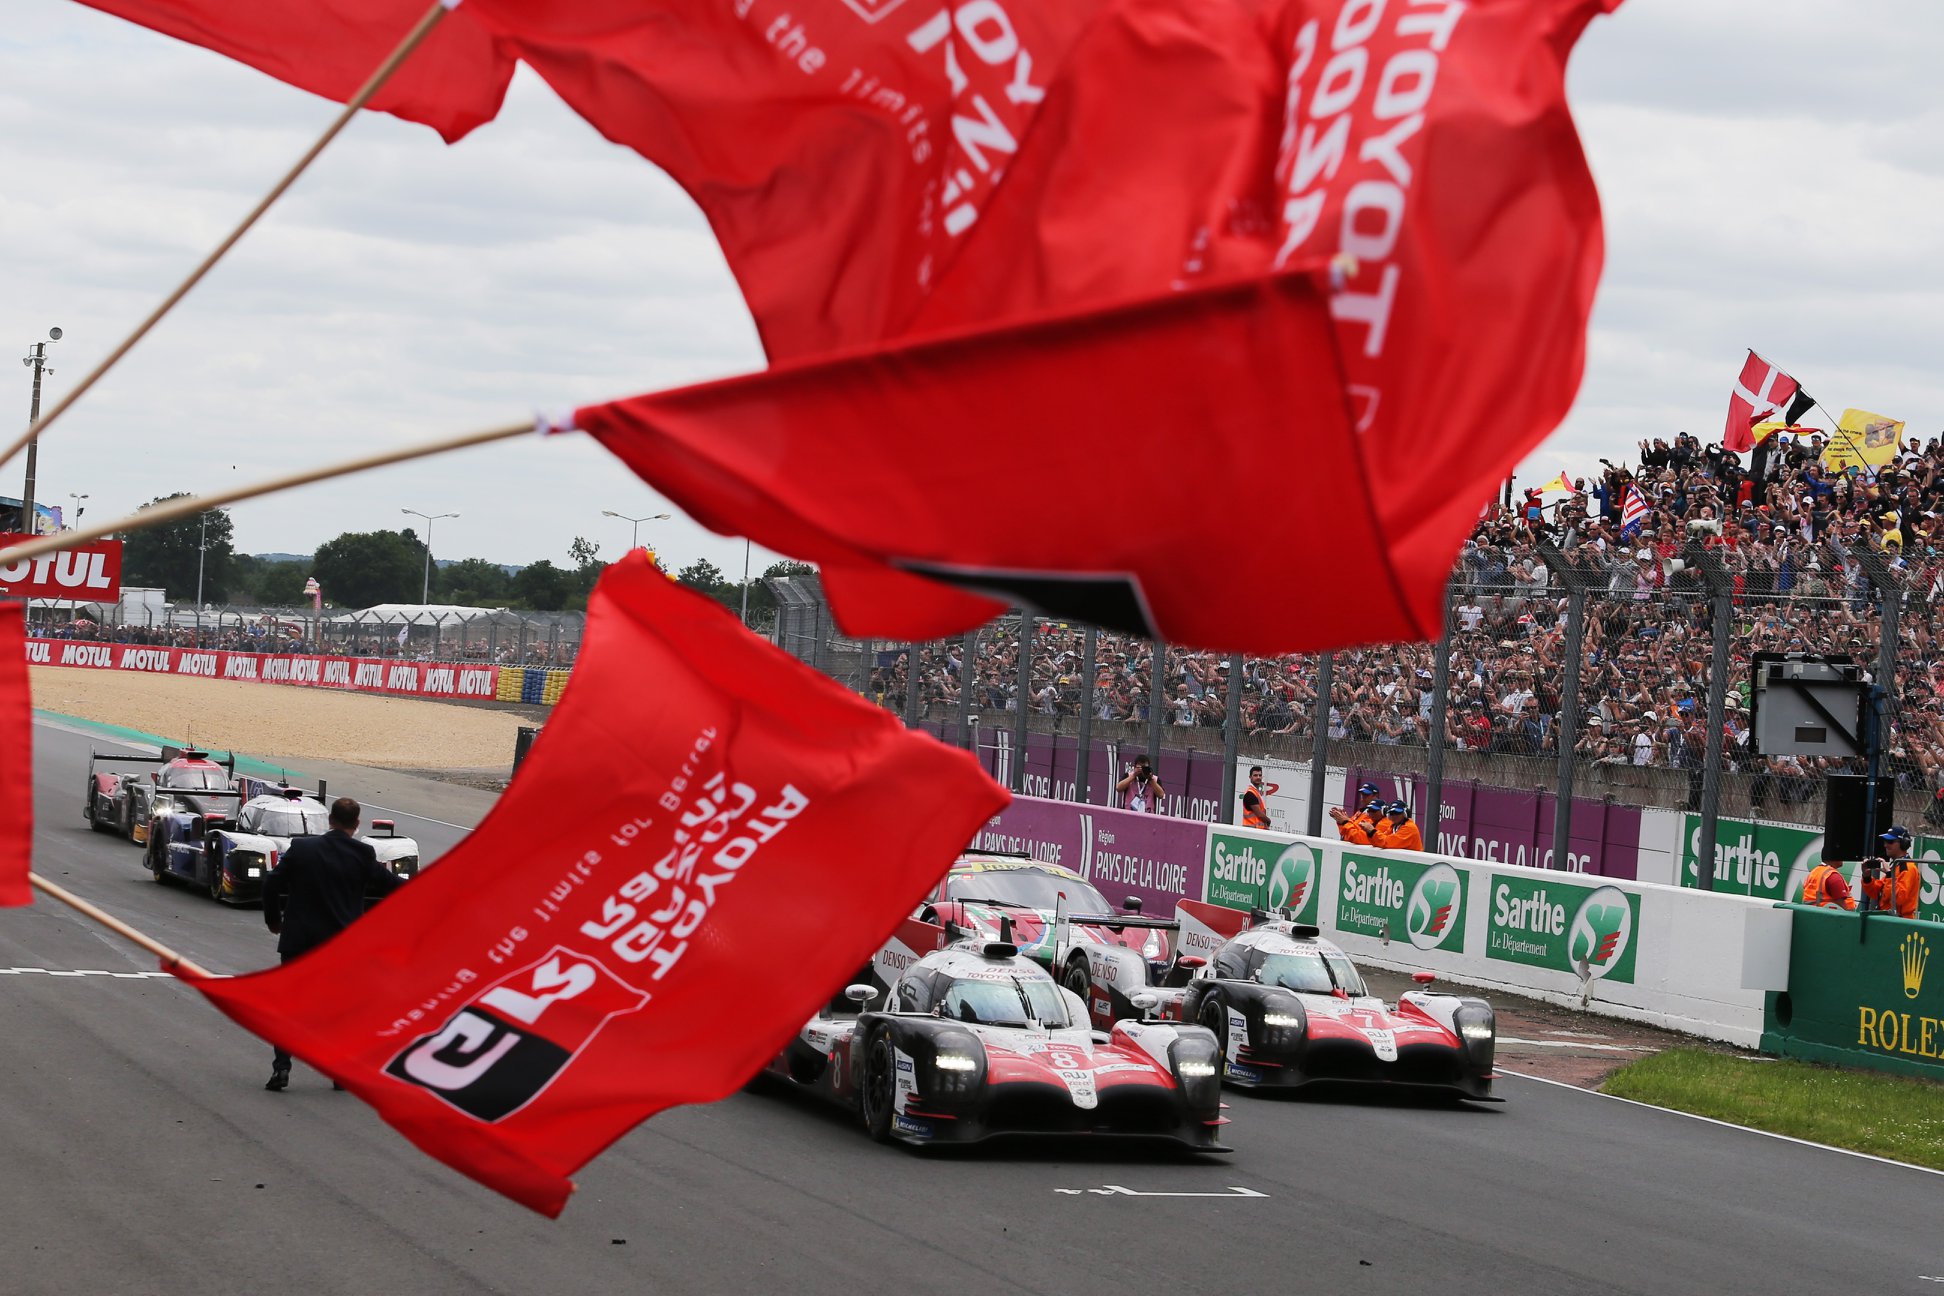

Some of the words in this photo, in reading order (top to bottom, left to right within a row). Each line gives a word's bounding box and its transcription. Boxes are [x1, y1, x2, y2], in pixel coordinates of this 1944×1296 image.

[765, 12, 827, 75] the
[840, 67, 932, 165] limits
[0, 546, 111, 589] OTUL
[26, 642, 51, 663] TUL
[61, 644, 112, 668] MOTUL
[120, 649, 170, 672] MOTUL
[178, 652, 217, 676] MOTUL
[224, 656, 258, 679] MOTUL
[262, 658, 290, 680] MOTUL
[290, 658, 319, 682] MOTUL
[323, 660, 350, 684] MOTUL
[354, 663, 383, 688] MOTUL
[388, 666, 418, 692] MOTUL
[424, 668, 455, 693] MOTUL
[458, 670, 492, 696] MOTUL
[1098, 828, 1116, 846] Région
[1437, 832, 1467, 859] AYS
[1095, 850, 1123, 885] PAYS
[1123, 855, 1139, 886] DE
[1139, 858, 1154, 888] LA
[1154, 861, 1188, 895] LOIRE
[1213, 841, 1267, 888] Sarthe
[1211, 883, 1220, 898] Le
[1220, 885, 1253, 905] Département
[1343, 861, 1405, 910] Sarthe
[1341, 905, 1350, 921] Le
[1350, 907, 1389, 929] Département
[1494, 883, 1566, 936] Sarthe
[1186, 932, 1210, 950] DENSO
[1492, 931, 1502, 949] Le
[1503, 932, 1548, 957] Département
[883, 949, 906, 970] DENSO
[1092, 961, 1118, 982] DENSO
[1354, 1013, 1374, 1028] 7
[833, 1051, 842, 1089] 8
[1050, 1052, 1079, 1069] 8
